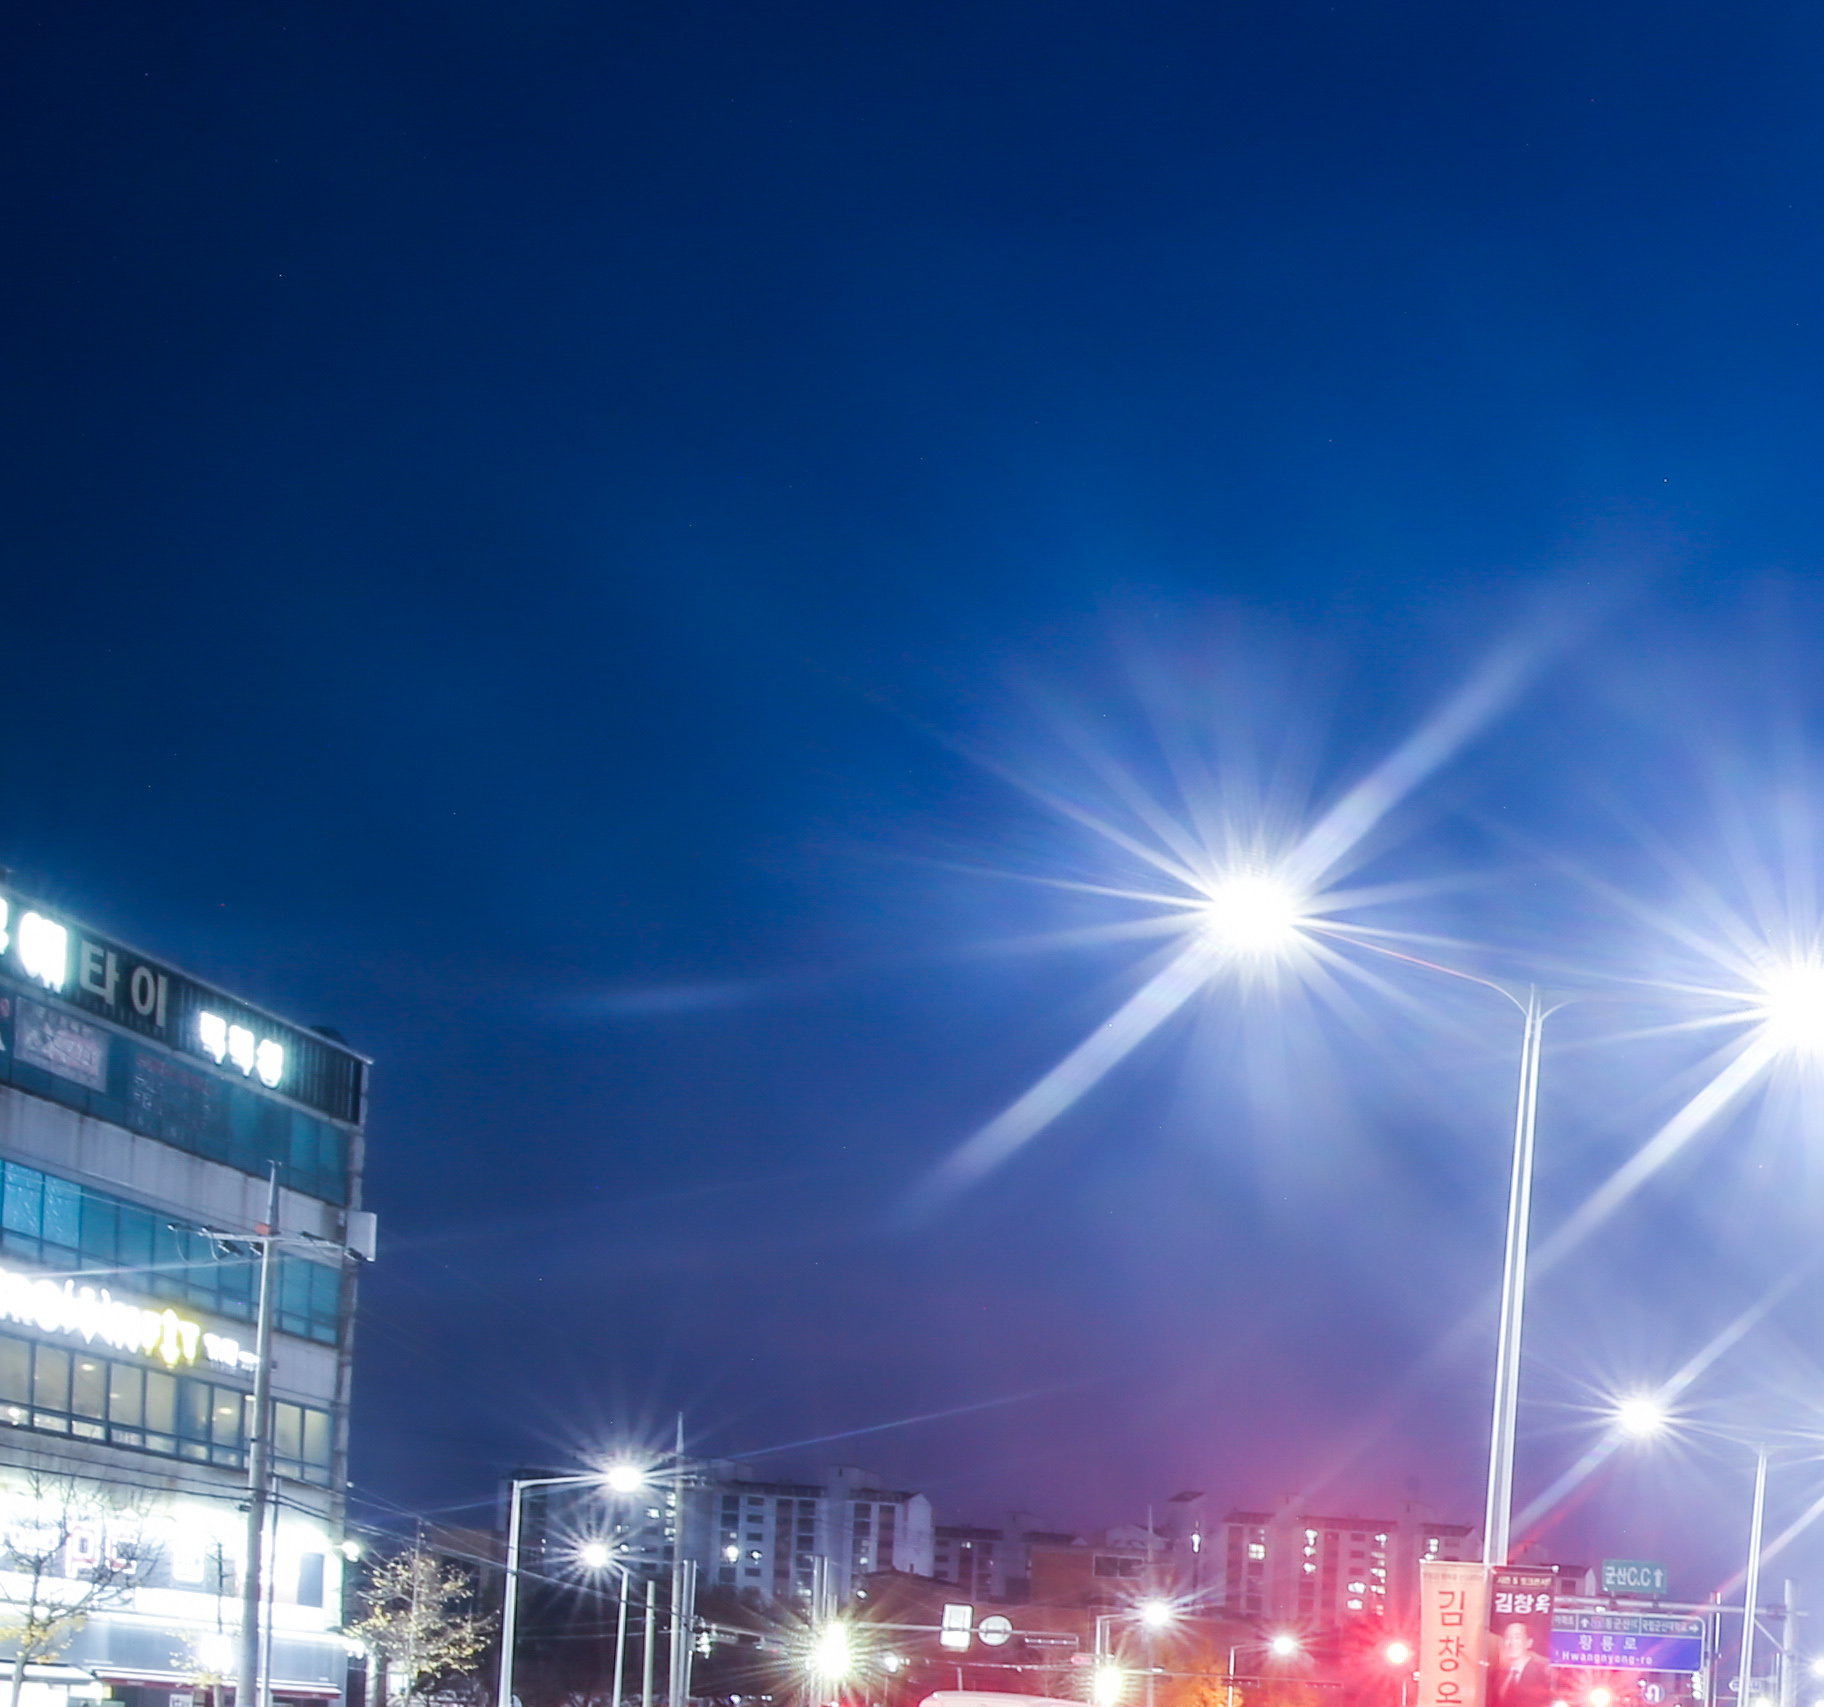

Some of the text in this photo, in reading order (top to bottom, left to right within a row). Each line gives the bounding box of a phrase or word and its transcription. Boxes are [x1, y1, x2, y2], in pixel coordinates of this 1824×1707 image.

[1605, 1565, 1651, 1587] 군산C.C
[1494, 1592, 1551, 1614] 김창옥
[1578, 1634, 1638, 1652] 황룡로
[1561, 1650, 1653, 1666] Hwangnyong-ro
